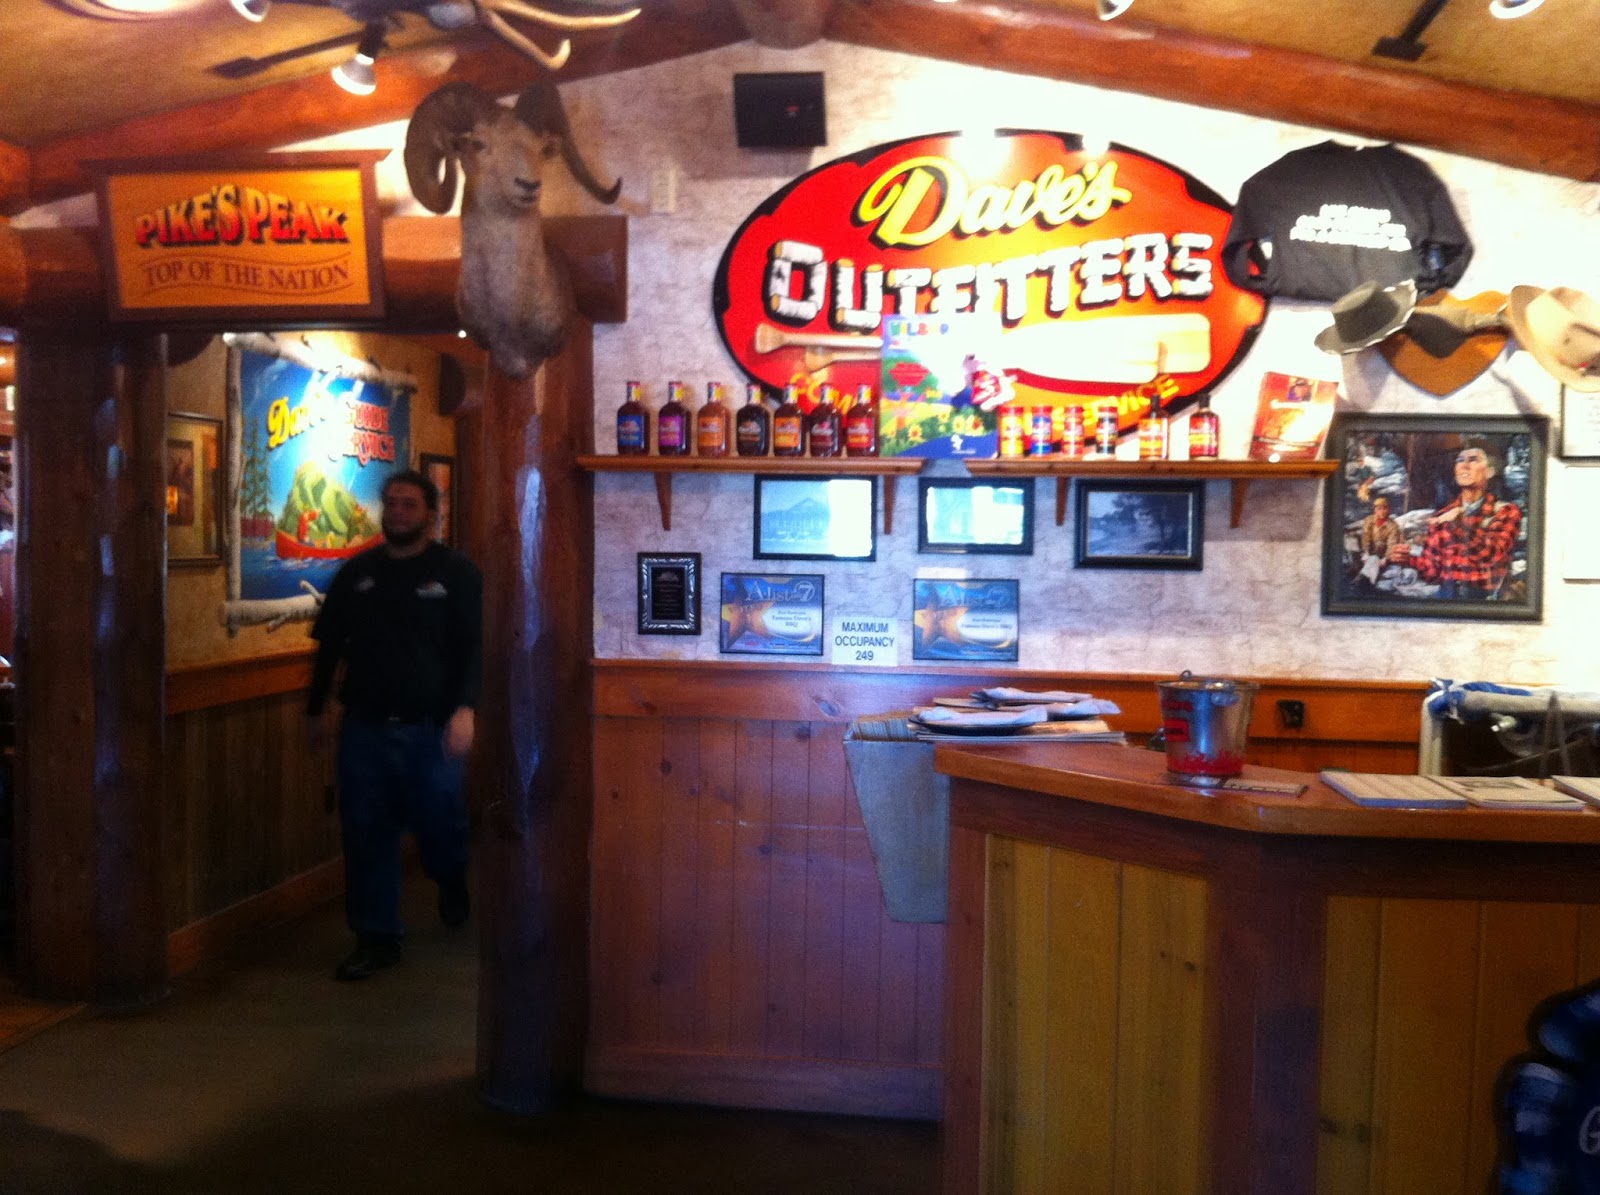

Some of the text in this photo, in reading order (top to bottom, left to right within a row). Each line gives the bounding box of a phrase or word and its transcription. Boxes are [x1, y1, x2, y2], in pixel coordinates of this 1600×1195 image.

[136, 183, 348, 247] PIKE'S PEAK
[856, 156, 1131, 246] Dave's
[149, 259, 349, 290] TOP OF THE NATION
[767, 232, 1213, 331] OUTFITTERS
[835, 635, 895, 647] OCCUPANCY
[842, 622, 889, 632] MAXIMUM
[856, 650, 874, 661] 249
